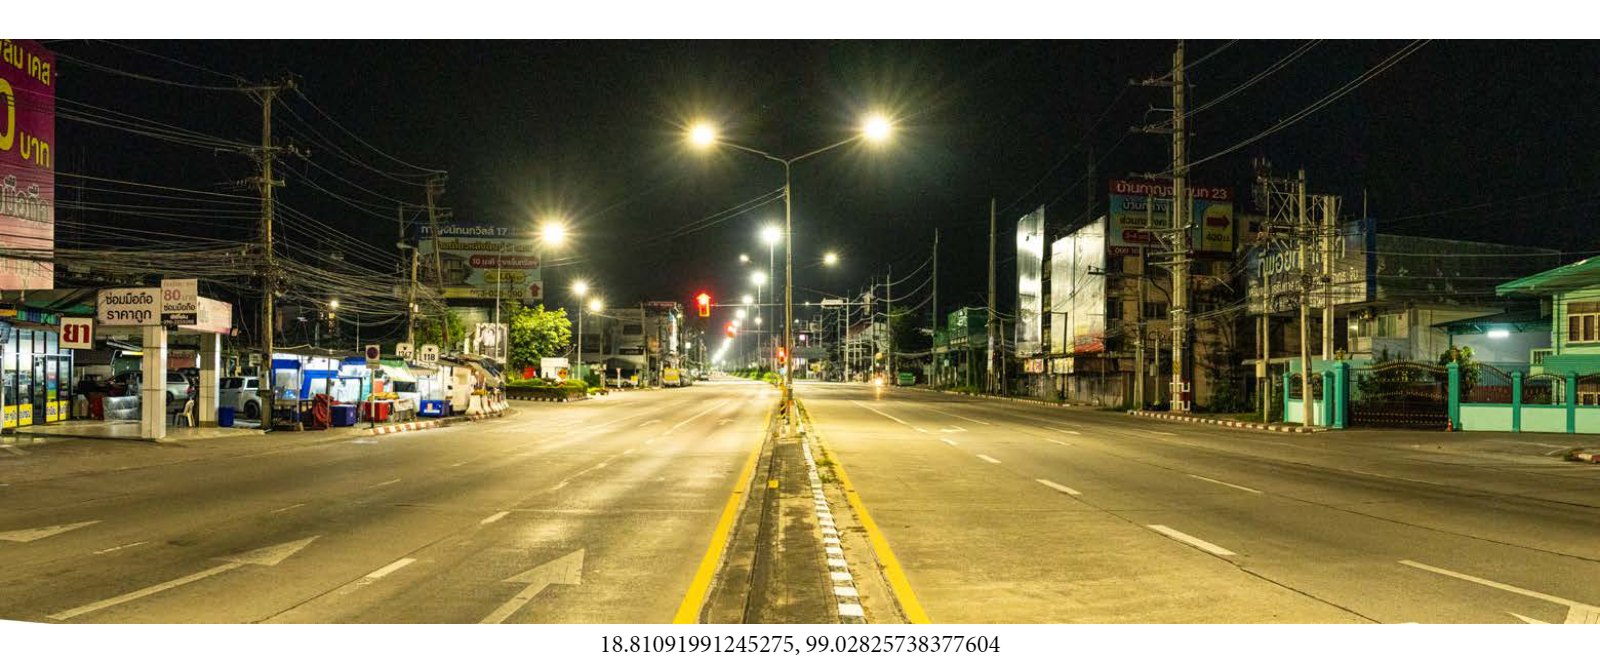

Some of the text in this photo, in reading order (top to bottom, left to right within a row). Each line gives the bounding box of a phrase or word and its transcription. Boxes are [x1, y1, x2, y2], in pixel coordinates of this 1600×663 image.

[28, 52, 51, 86] เคส
[20, 131, 50, 168] บาท
[1212, 187, 1227, 199] 23
[496, 227, 508, 236] 17
[106, 292, 154, 305] ซ่อมมือถือ
[164, 289, 181, 301] 80
[164, 303, 196, 311] ซ่อมมือถือ
[106, 309, 152, 323] ราคาถูก
[63, 324, 90, 343] ยา
